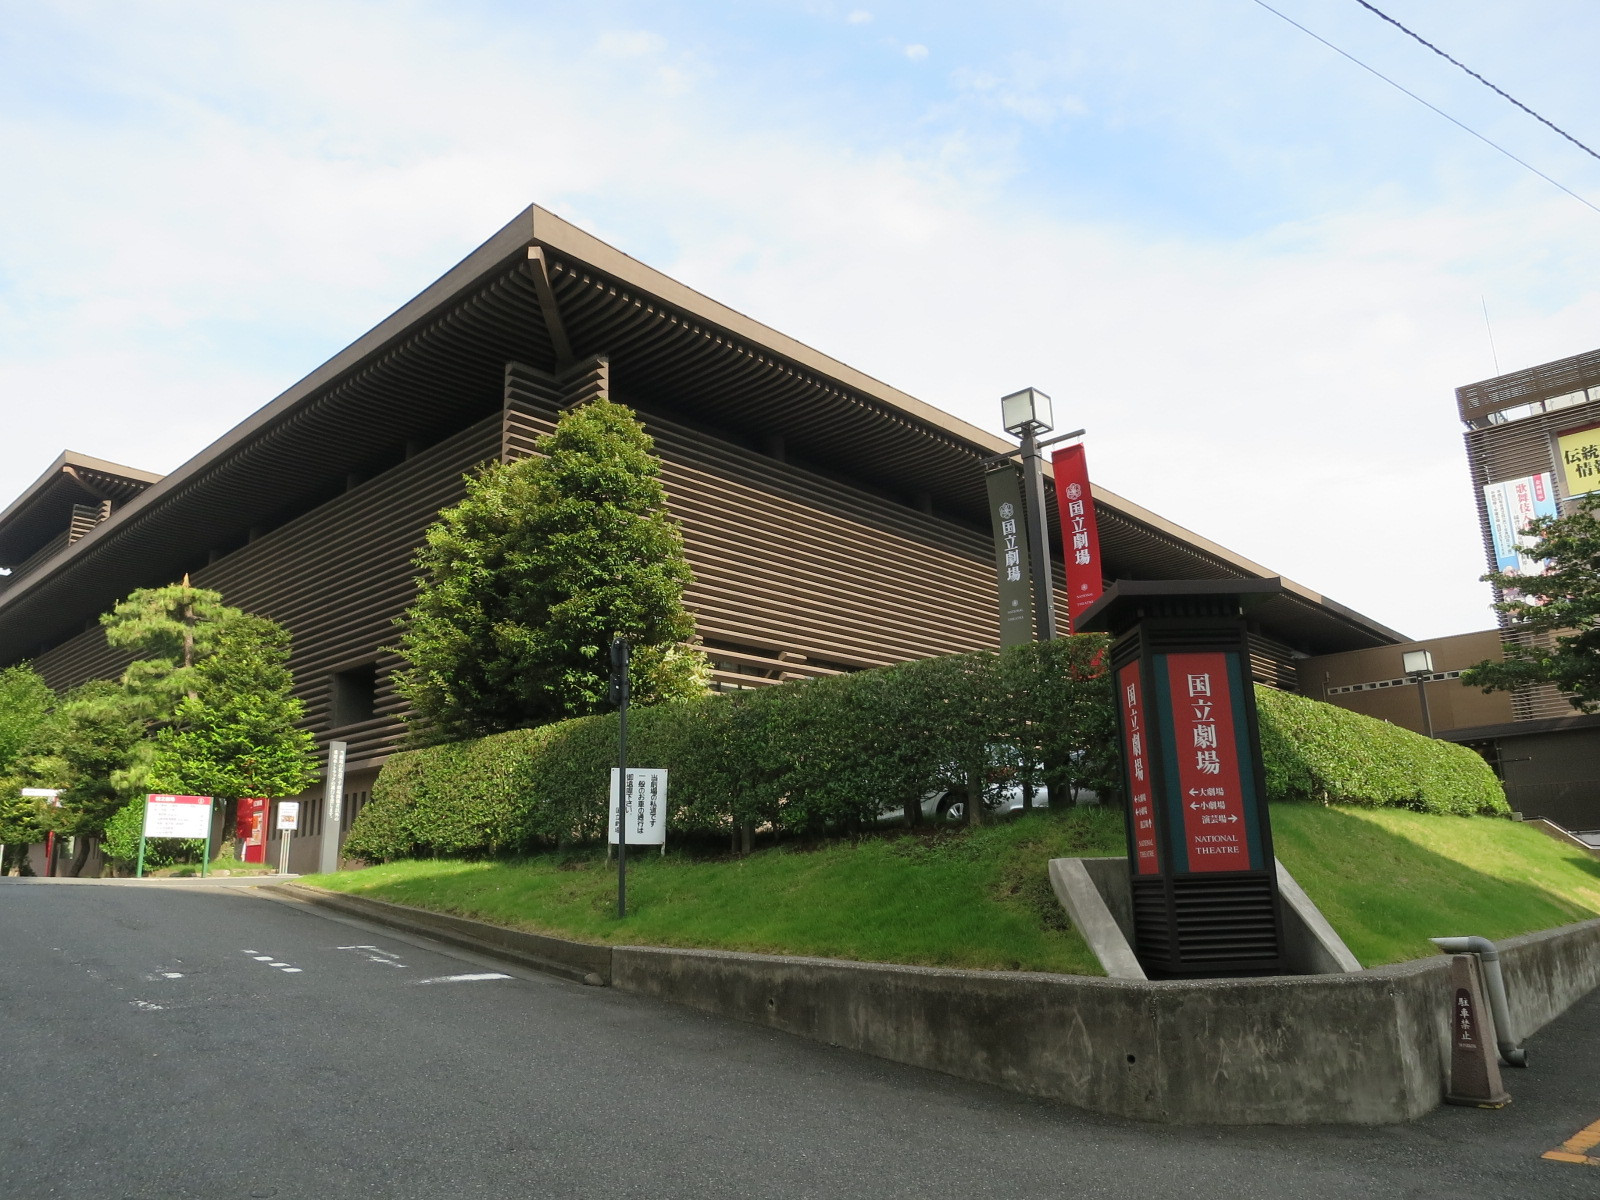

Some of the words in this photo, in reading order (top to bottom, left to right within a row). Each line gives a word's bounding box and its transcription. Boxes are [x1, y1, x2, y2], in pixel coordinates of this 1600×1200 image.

[1068, 500, 1091, 566] 国立劇場
[1001, 518, 1021, 582] 国立劇場
[1126, 683, 1144, 782] 国立劇場
[1187, 673, 1220, 775] 国立劇場
[1199, 787, 1225, 797] 大劇場
[1201, 801, 1226, 810] 小劇場
[1202, 815, 1227, 824] 演芸場
[1195, 835, 1238, 843] NATIONAL
[1195, 846, 1239, 855] THEATRE
[1458, 997, 1472, 1041] 駐車禁止
